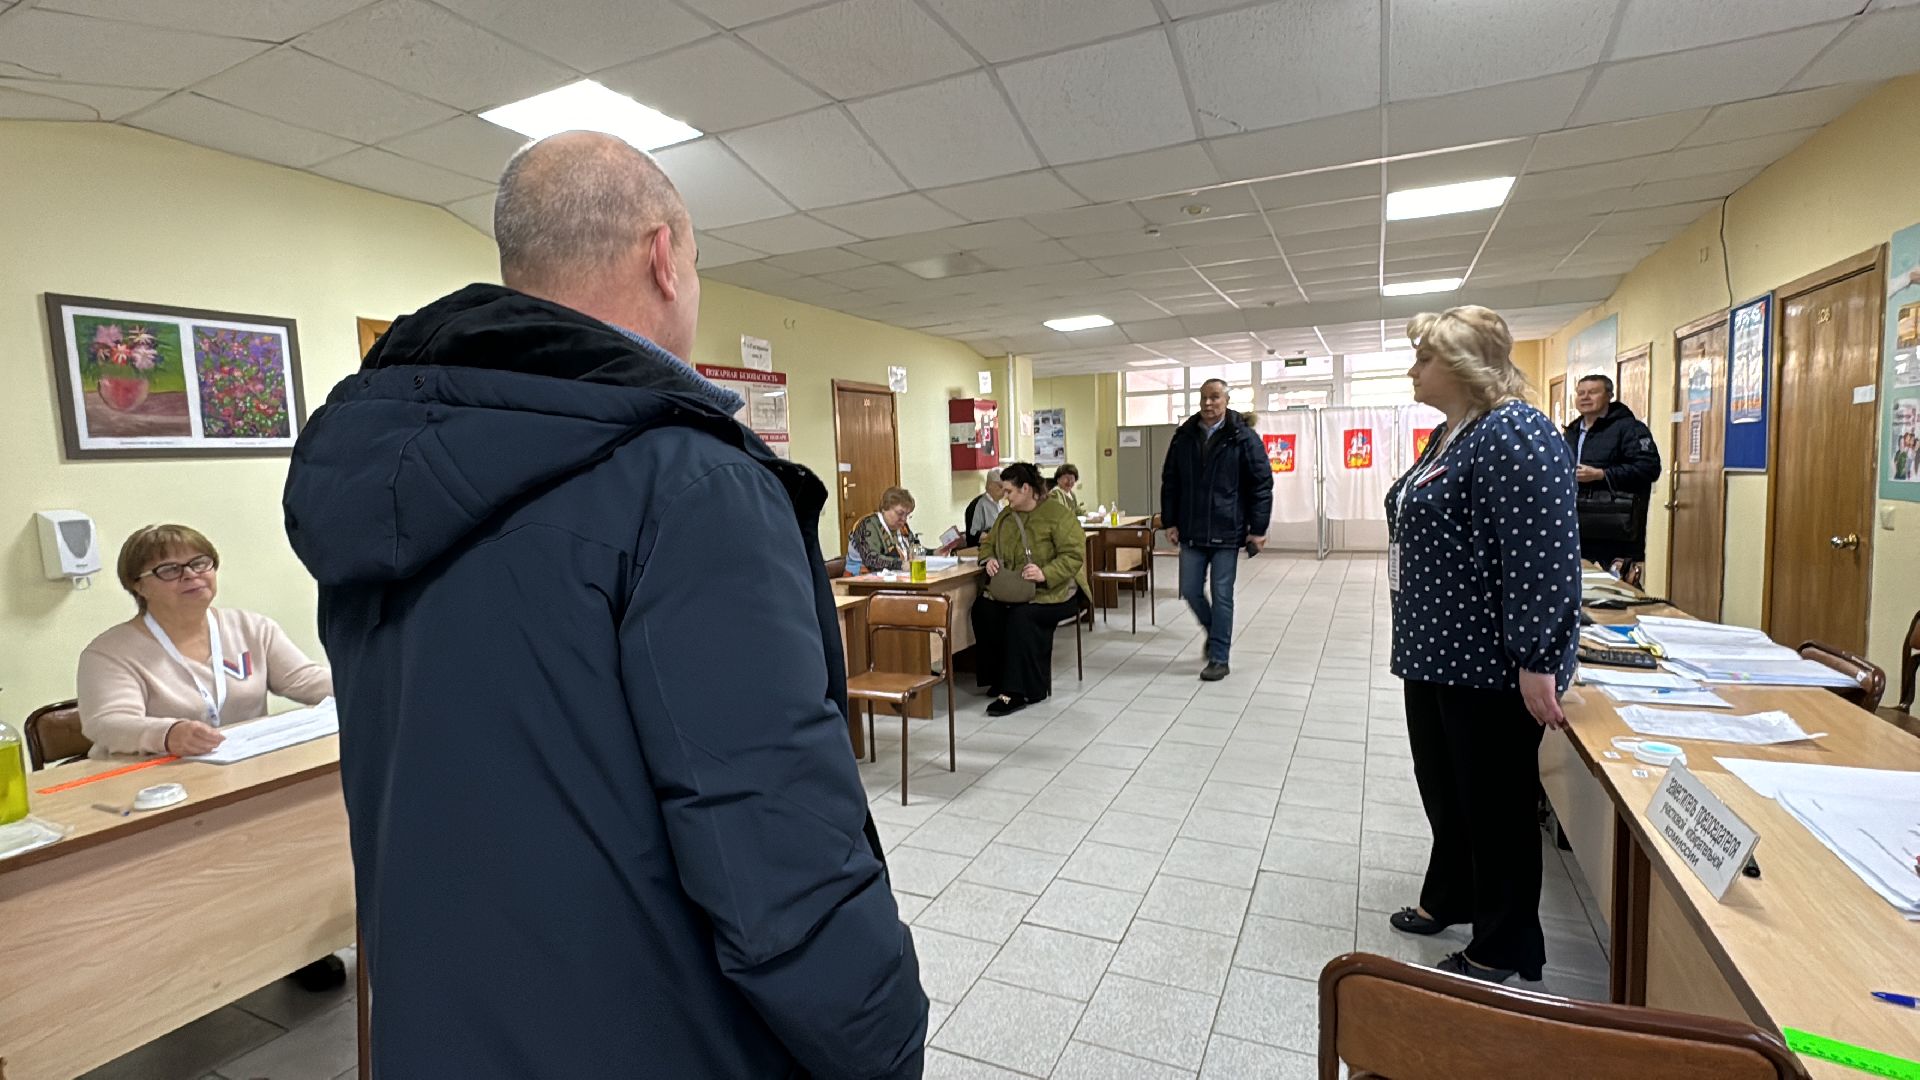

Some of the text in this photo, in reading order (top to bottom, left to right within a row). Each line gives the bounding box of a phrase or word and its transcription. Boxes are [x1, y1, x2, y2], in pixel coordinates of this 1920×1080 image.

[705, 368, 778, 382] ПОЖАРНАЯ БЕЗОПАСНОСТЬ
[1694, 805, 1741, 859] председателя
